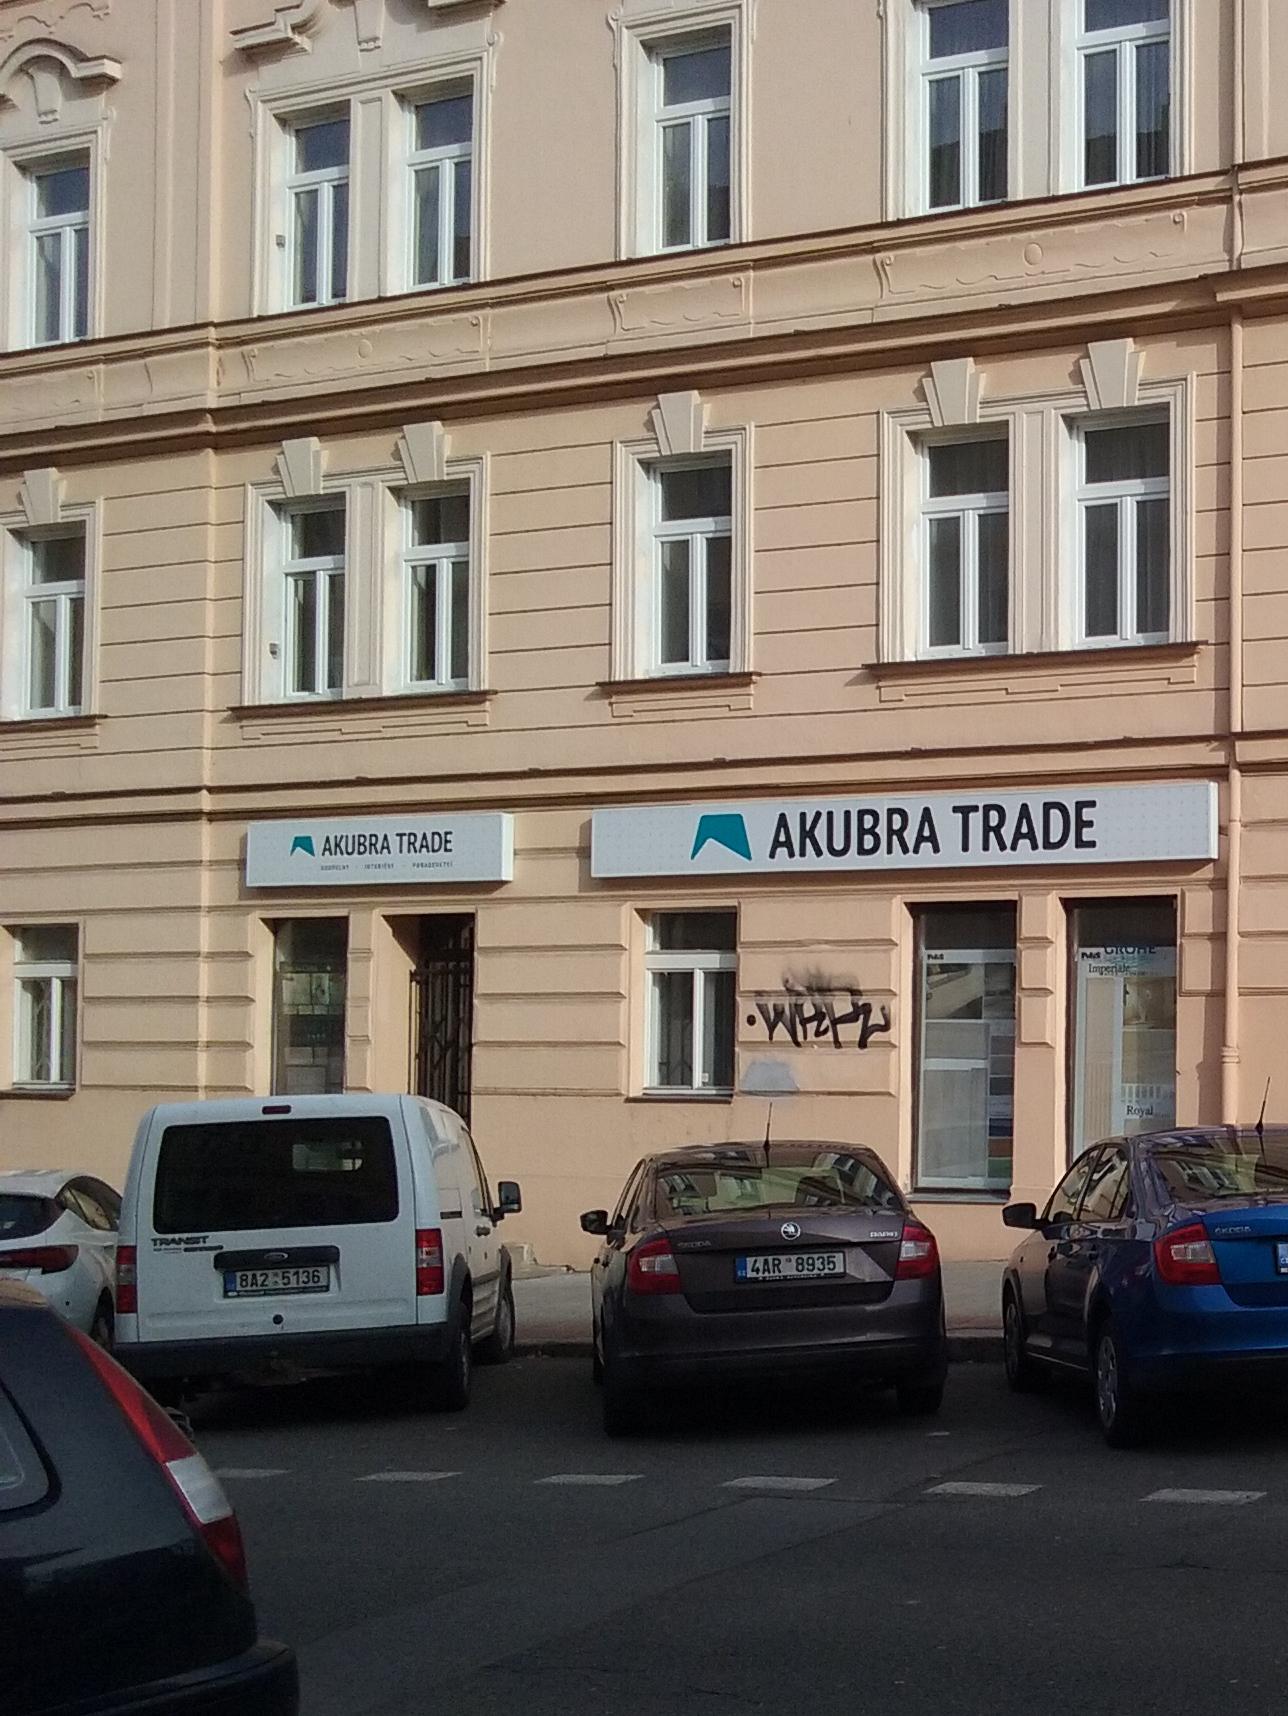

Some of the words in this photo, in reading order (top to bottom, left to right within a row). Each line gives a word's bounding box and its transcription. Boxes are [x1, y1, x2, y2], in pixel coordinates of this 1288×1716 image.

[768, 806, 942, 859] AKUBRA
[951, 800, 1098, 853] TRADE
[321, 833, 392, 857] AKUBRA
[395, 830, 454, 854] TRADE
[1126, 1105, 1154, 1118] Royal
[151, 1235, 209, 1247] TRANSIT
[750, 1257, 782, 1275] 4AR
[795, 1255, 837, 1272] 8935
[239, 1273, 269, 1289] 8A2
[281, 1270, 321, 1286] 5136
